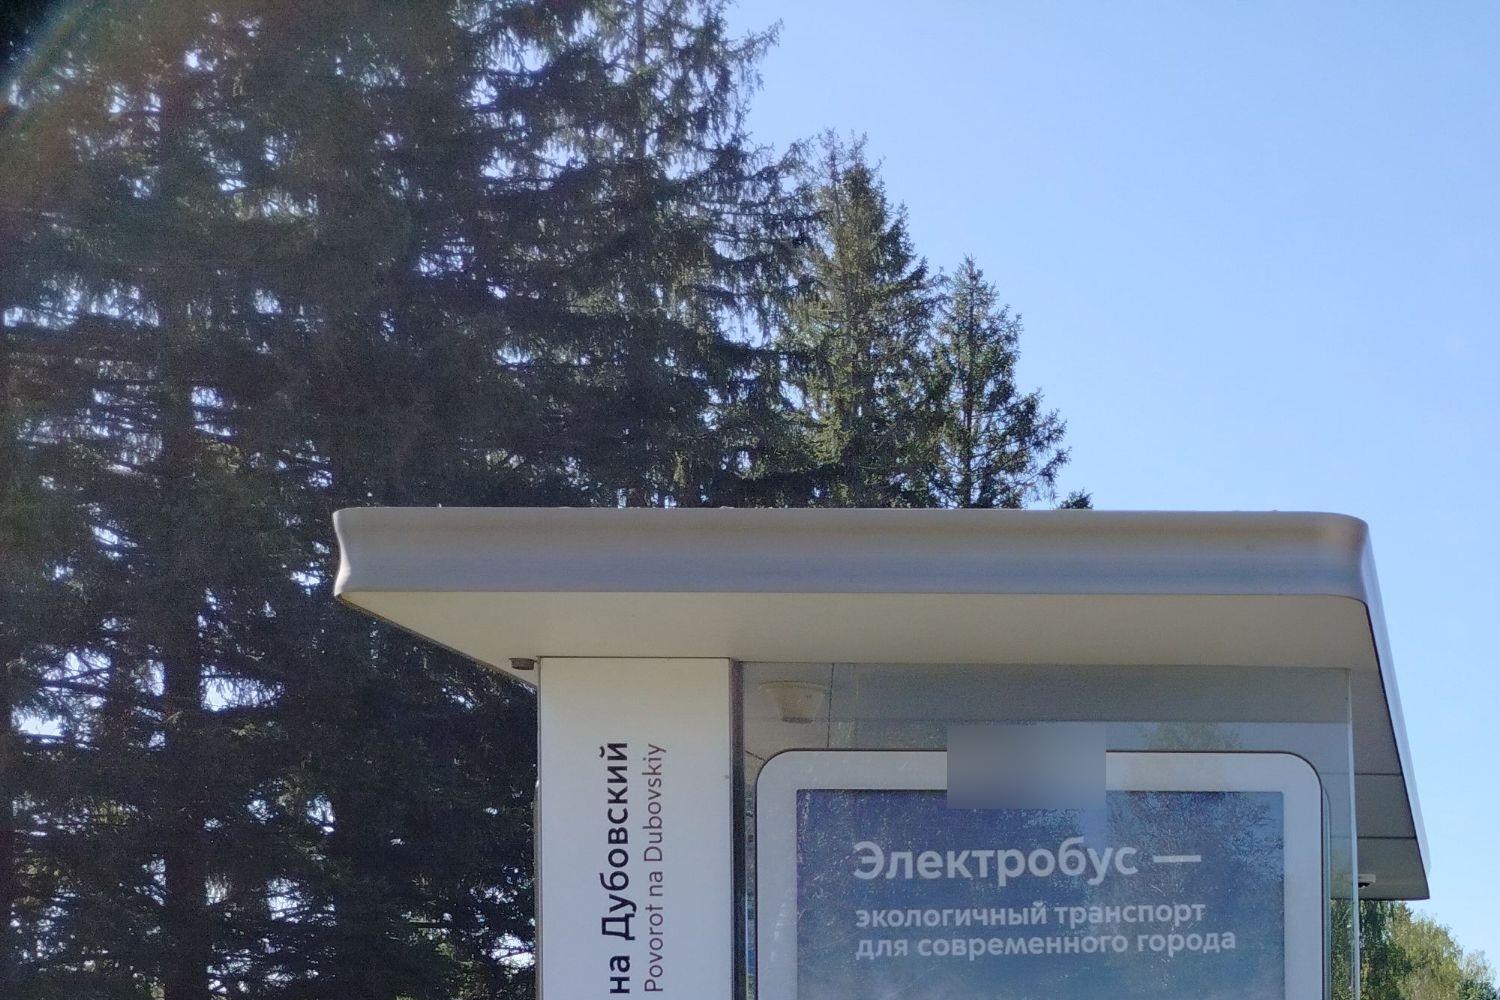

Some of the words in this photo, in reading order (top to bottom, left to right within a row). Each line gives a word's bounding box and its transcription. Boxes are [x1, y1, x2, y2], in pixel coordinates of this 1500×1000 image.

[642, 743, 668, 862] Dubovskiy
[599, 742, 637, 941] Дубовский
[852, 837, 1139, 886] Электробус
[650, 870, 664, 897] na
[855, 902, 1048, 928] экологичный
[1054, 901, 1206, 928] транспорт
[644, 904, 664, 993] Povorot
[855, 939, 909, 961] для
[917, 934, 1129, 961] современного
[1137, 931, 1236, 957] города
[608, 954, 631, 995] на
